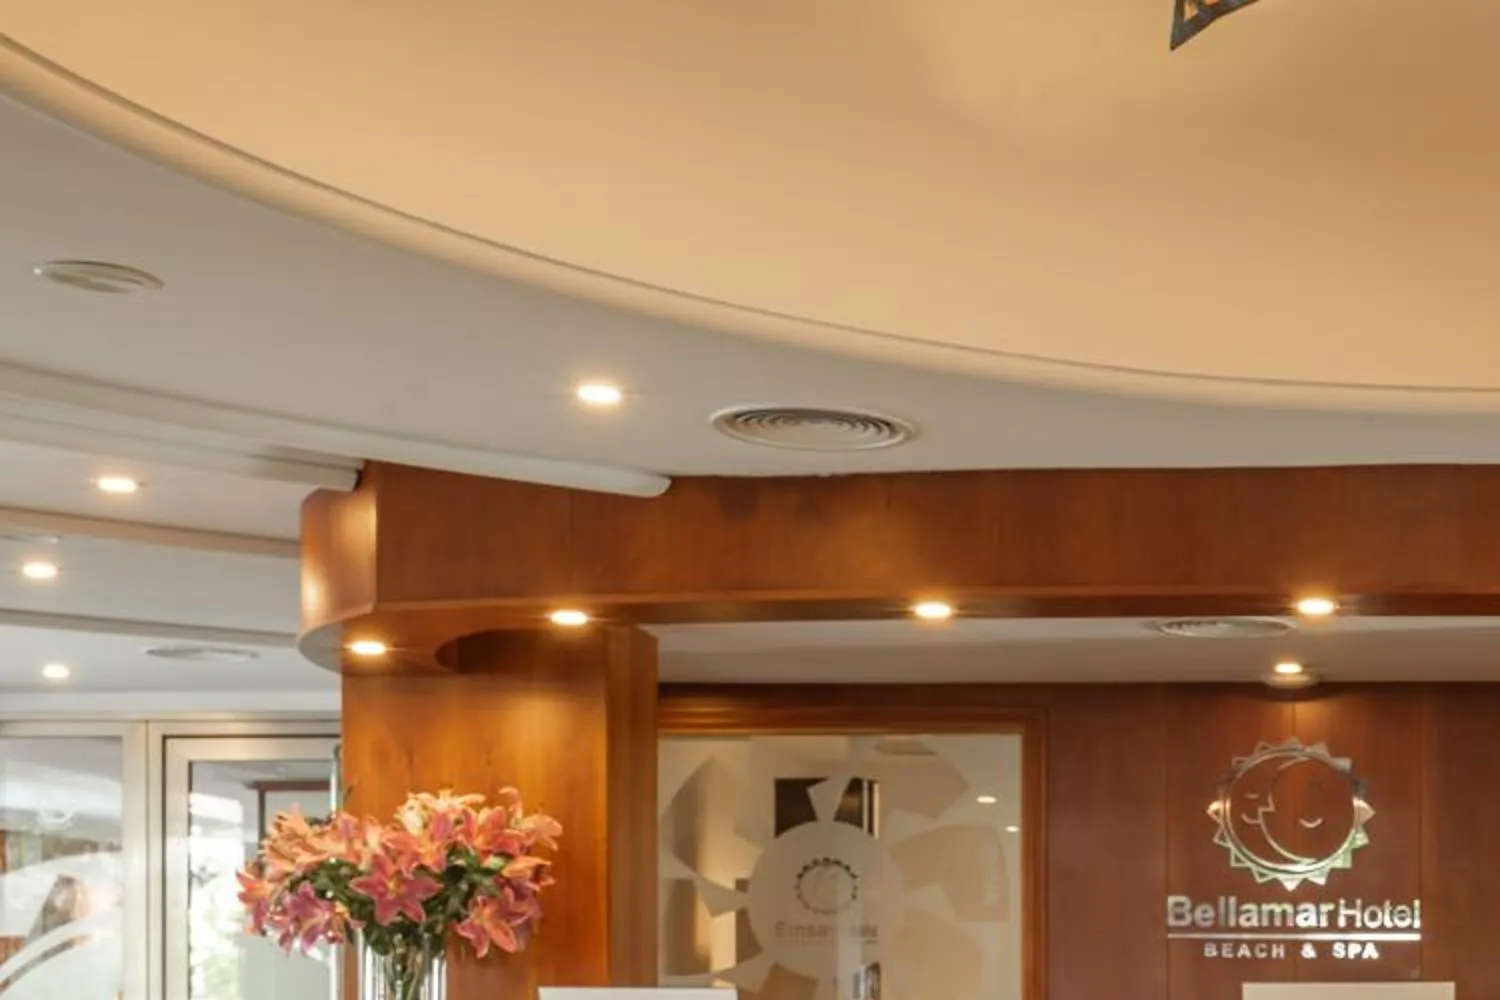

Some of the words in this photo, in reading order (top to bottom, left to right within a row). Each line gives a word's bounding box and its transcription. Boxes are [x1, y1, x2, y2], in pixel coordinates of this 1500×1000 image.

[1167, 896, 1334, 928] Bellamar
[1338, 899, 1421, 928] Hotel
[1204, 943, 1286, 959] BEACH
[1301, 942, 1318, 959] &
[1332, 942, 1380, 960] SPA
